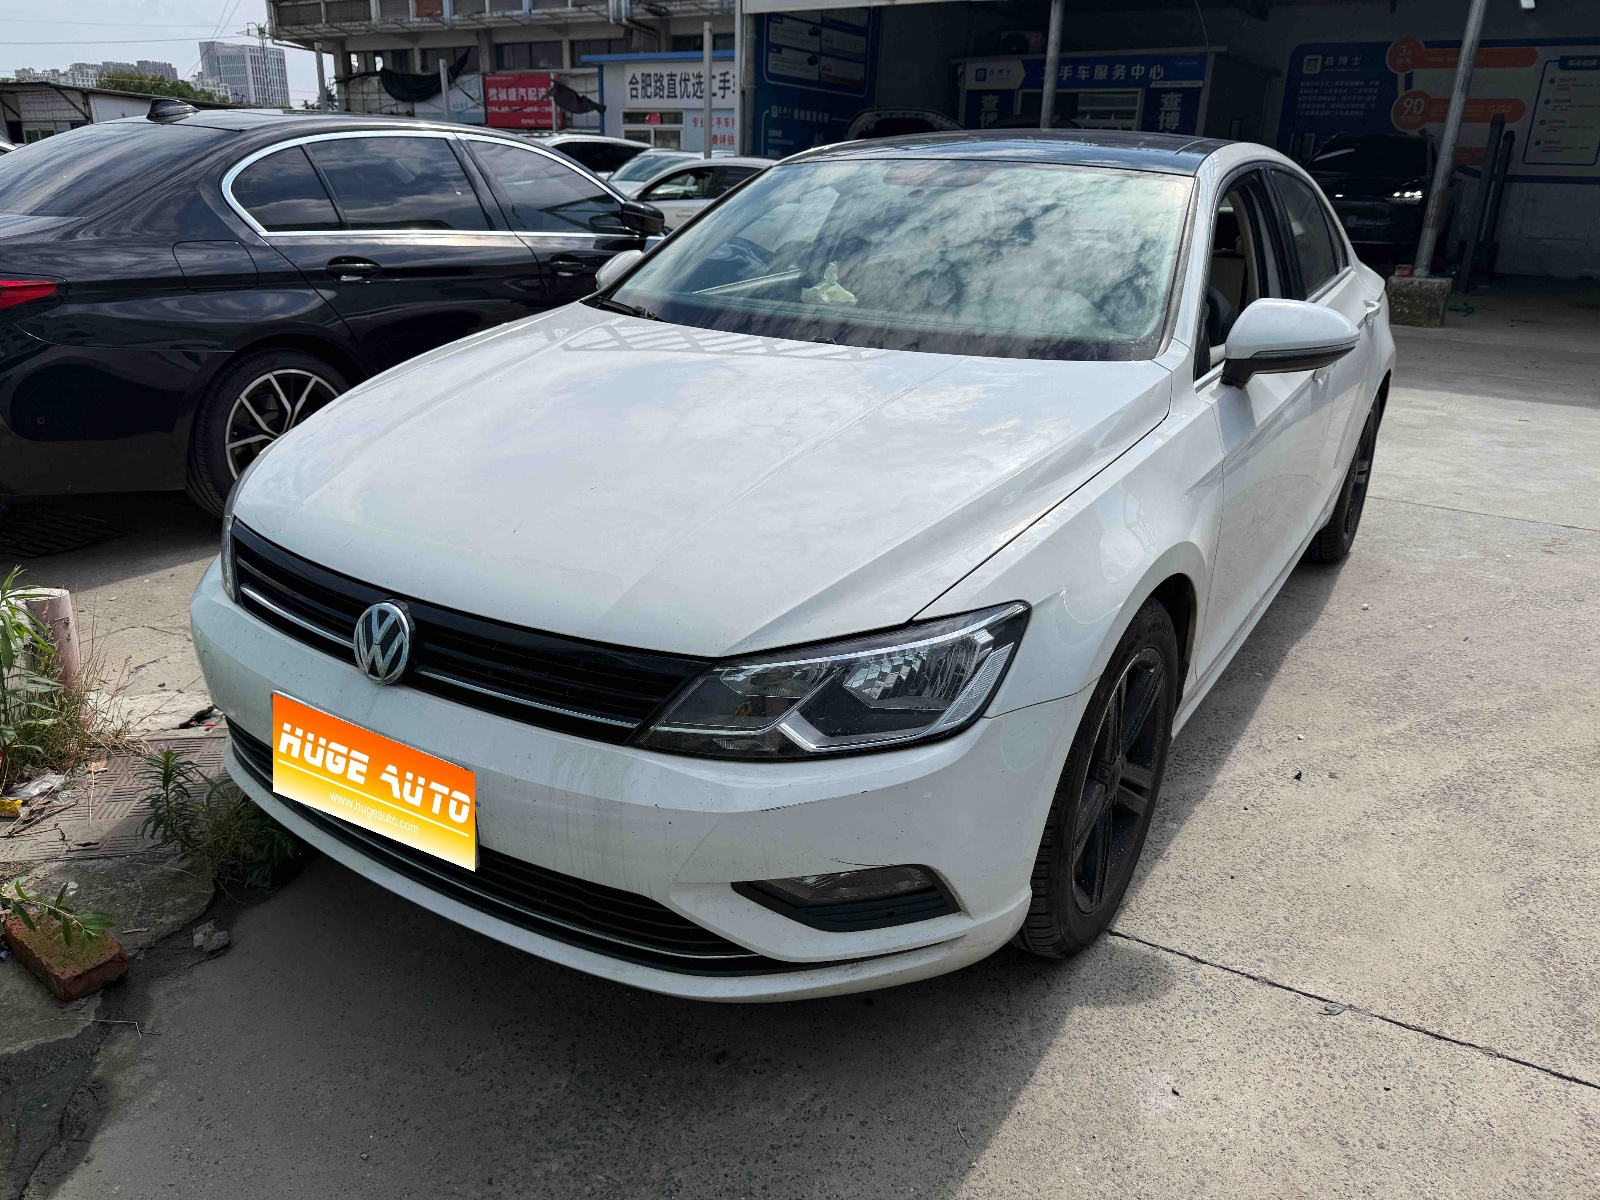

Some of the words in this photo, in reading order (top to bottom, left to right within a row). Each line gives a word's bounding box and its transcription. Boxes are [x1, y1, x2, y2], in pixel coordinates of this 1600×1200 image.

[1041, 64, 1165, 81] 手车服务中心
[628, 71, 735, 100] 合肥路直优选手
[1403, 97, 1425, 115] 90
